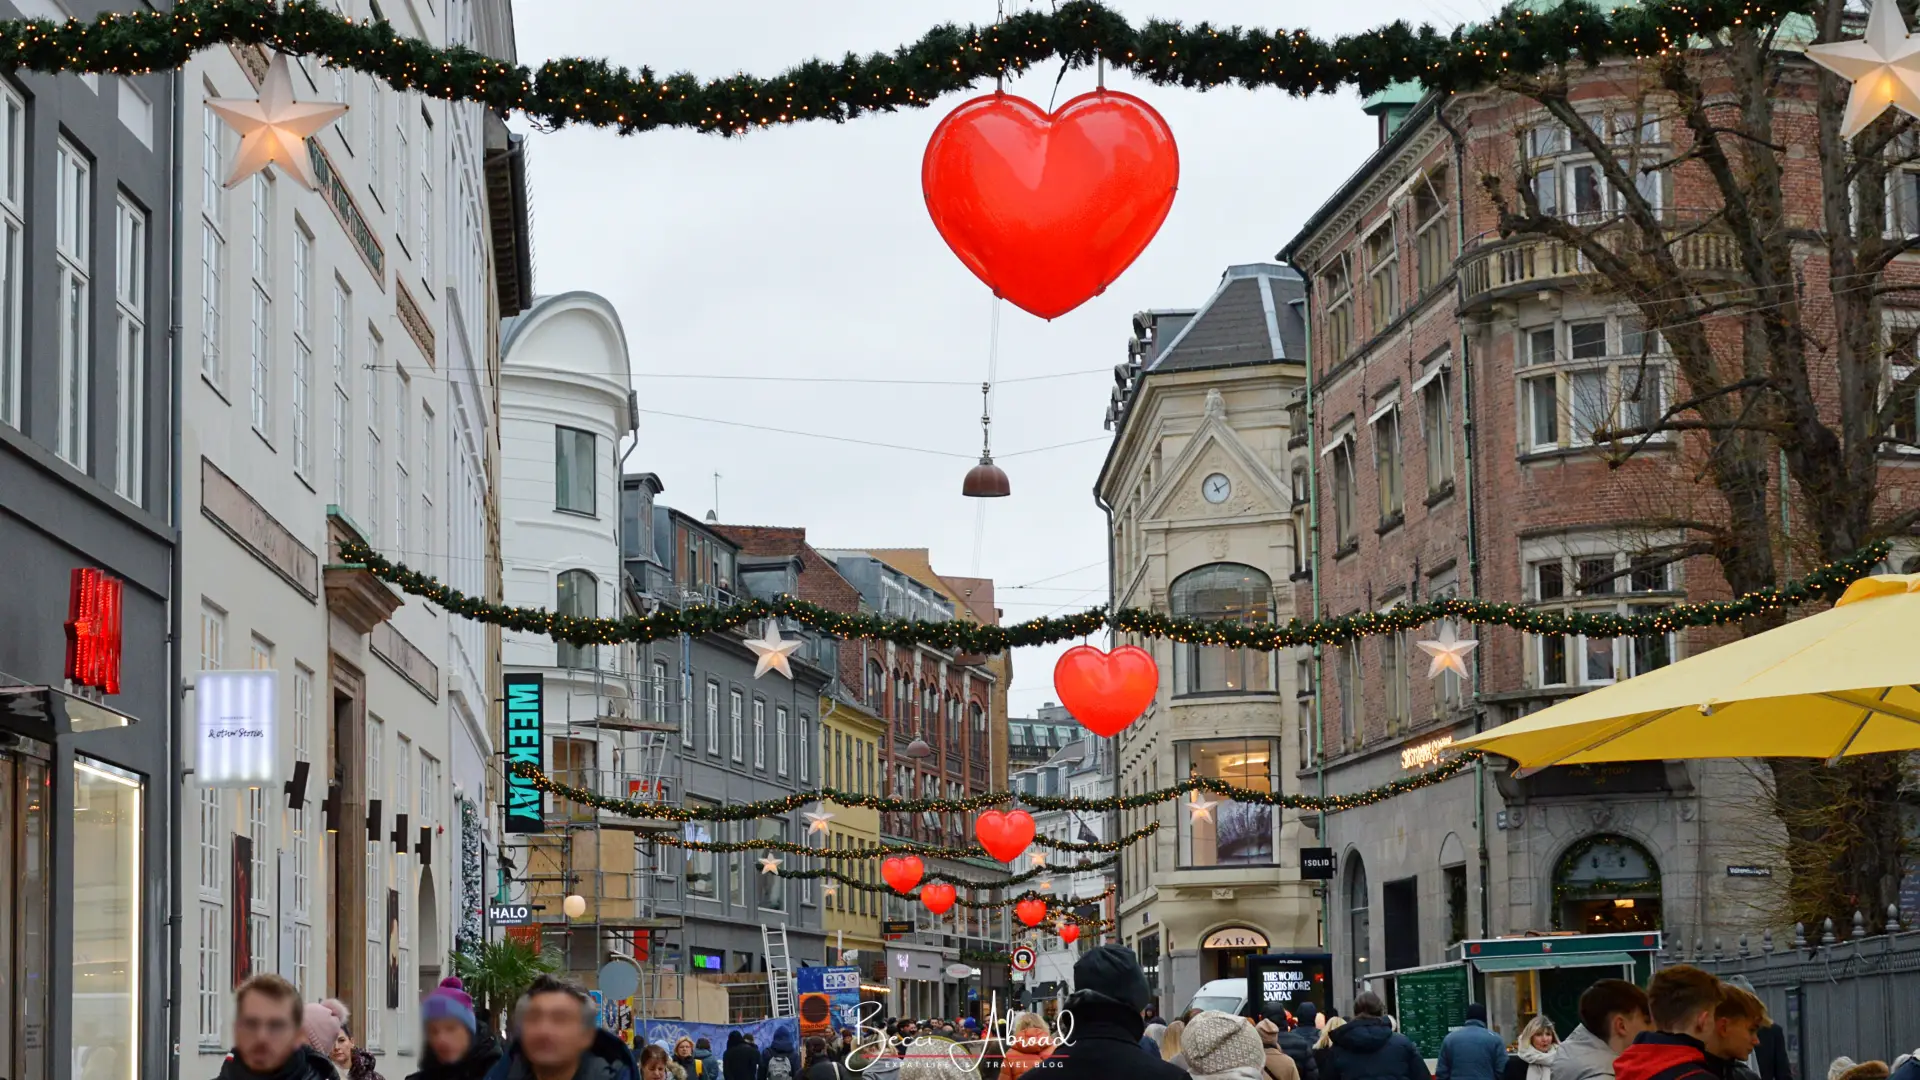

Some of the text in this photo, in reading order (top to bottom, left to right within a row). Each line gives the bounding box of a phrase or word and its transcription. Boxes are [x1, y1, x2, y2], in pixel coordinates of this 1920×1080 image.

[208, 729, 216, 739] &
[238, 727, 264, 739] Stories
[1304, 859, 1330, 867] !SOLID
[490, 907, 528, 919] HALO
[1212, 937, 1257, 946] ZARA
[1262, 971, 1304, 981] THE WORLD
[1263, 981, 1311, 991] NEEDS MORE
[1263, 991, 1292, 1001] SANTAS
